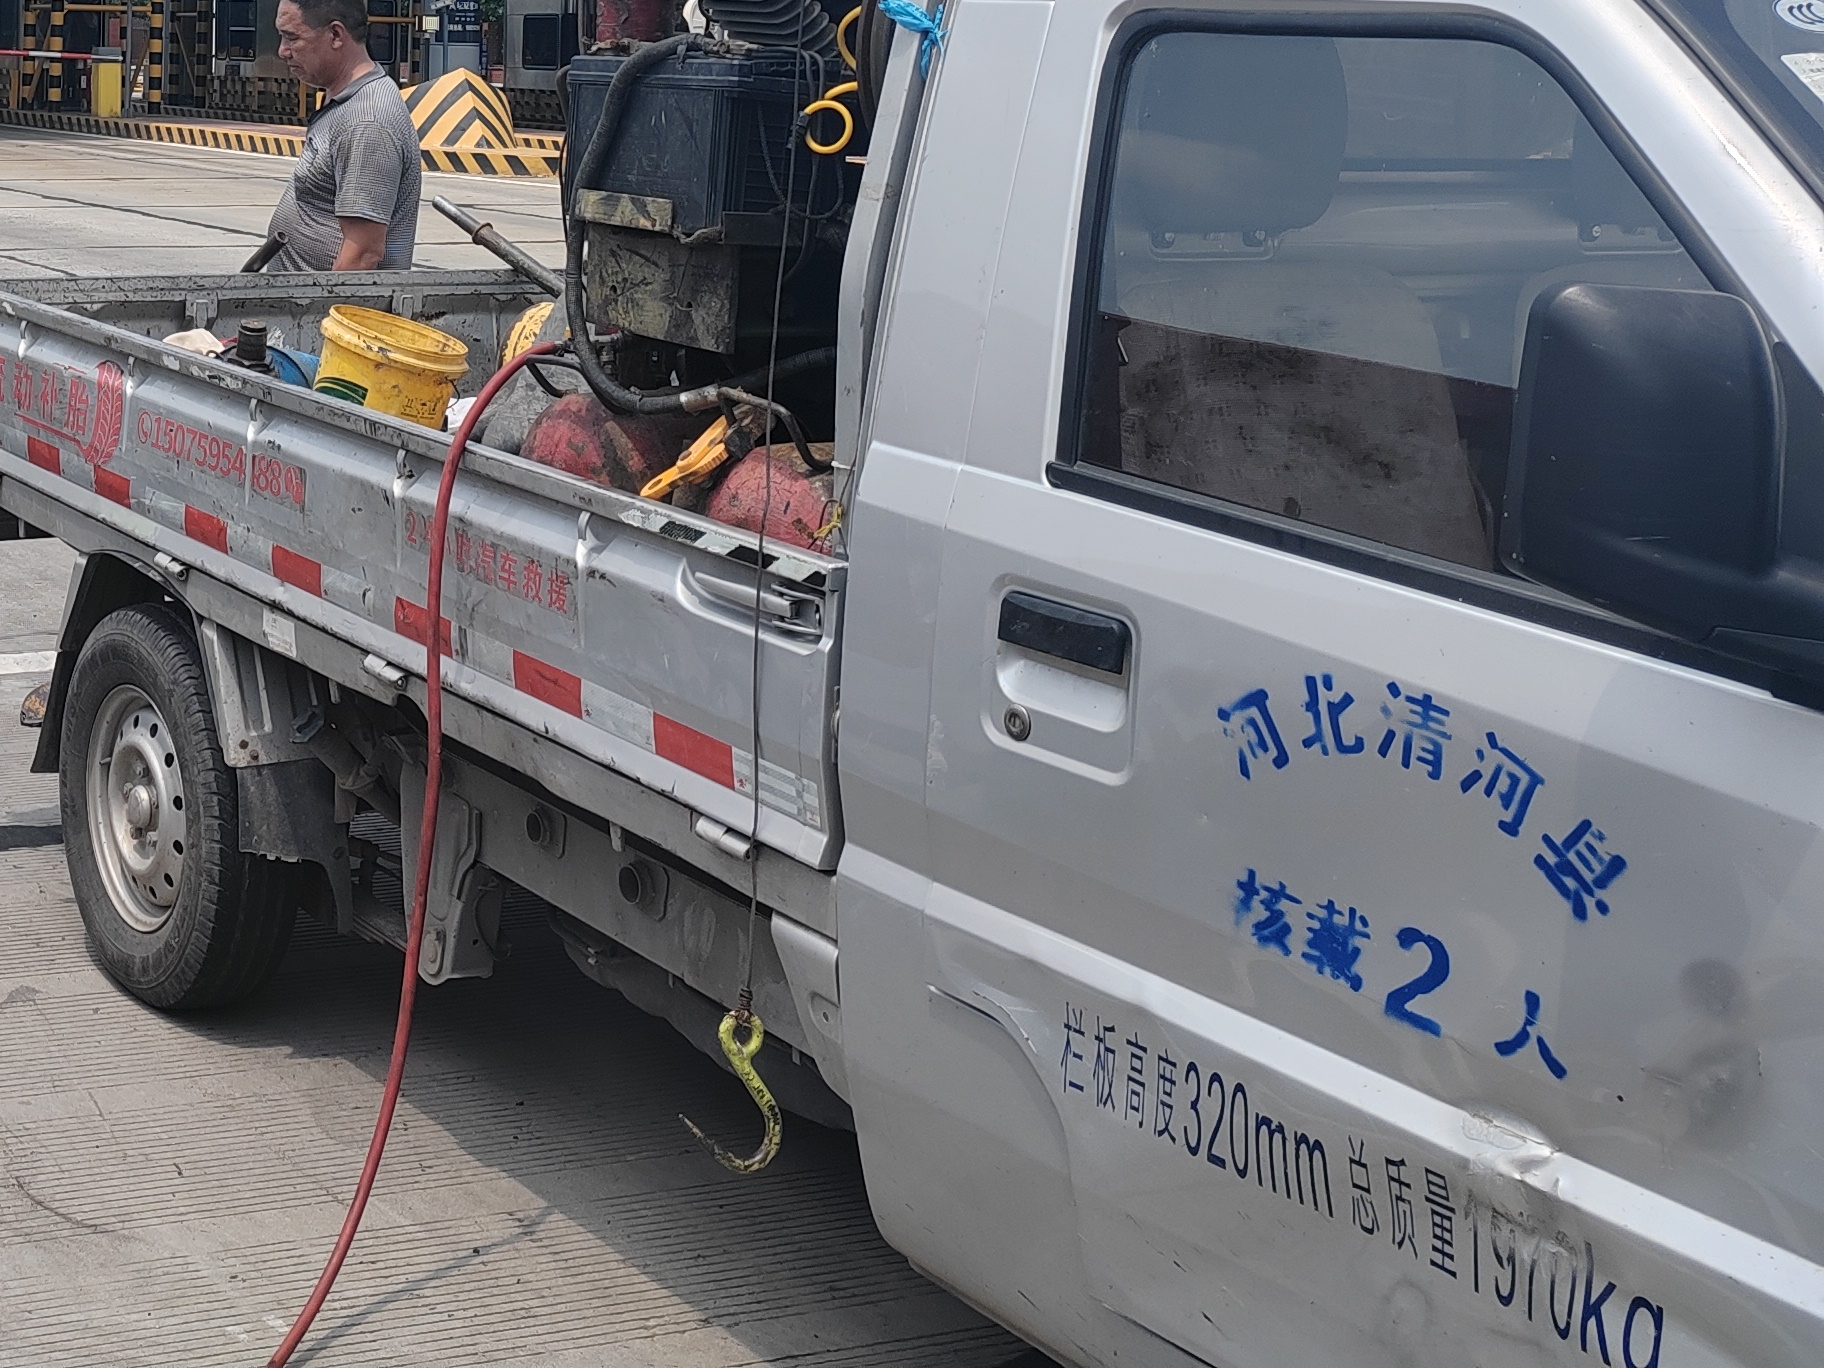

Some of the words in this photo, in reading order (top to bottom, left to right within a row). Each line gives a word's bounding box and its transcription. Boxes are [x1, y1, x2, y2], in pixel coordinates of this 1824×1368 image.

[406, 511, 569, 614] 2时汽车救援
[1216, 672, 1629, 923] 河北清河县
[1060, 1000, 1335, 1219] 栏板高度320mm
